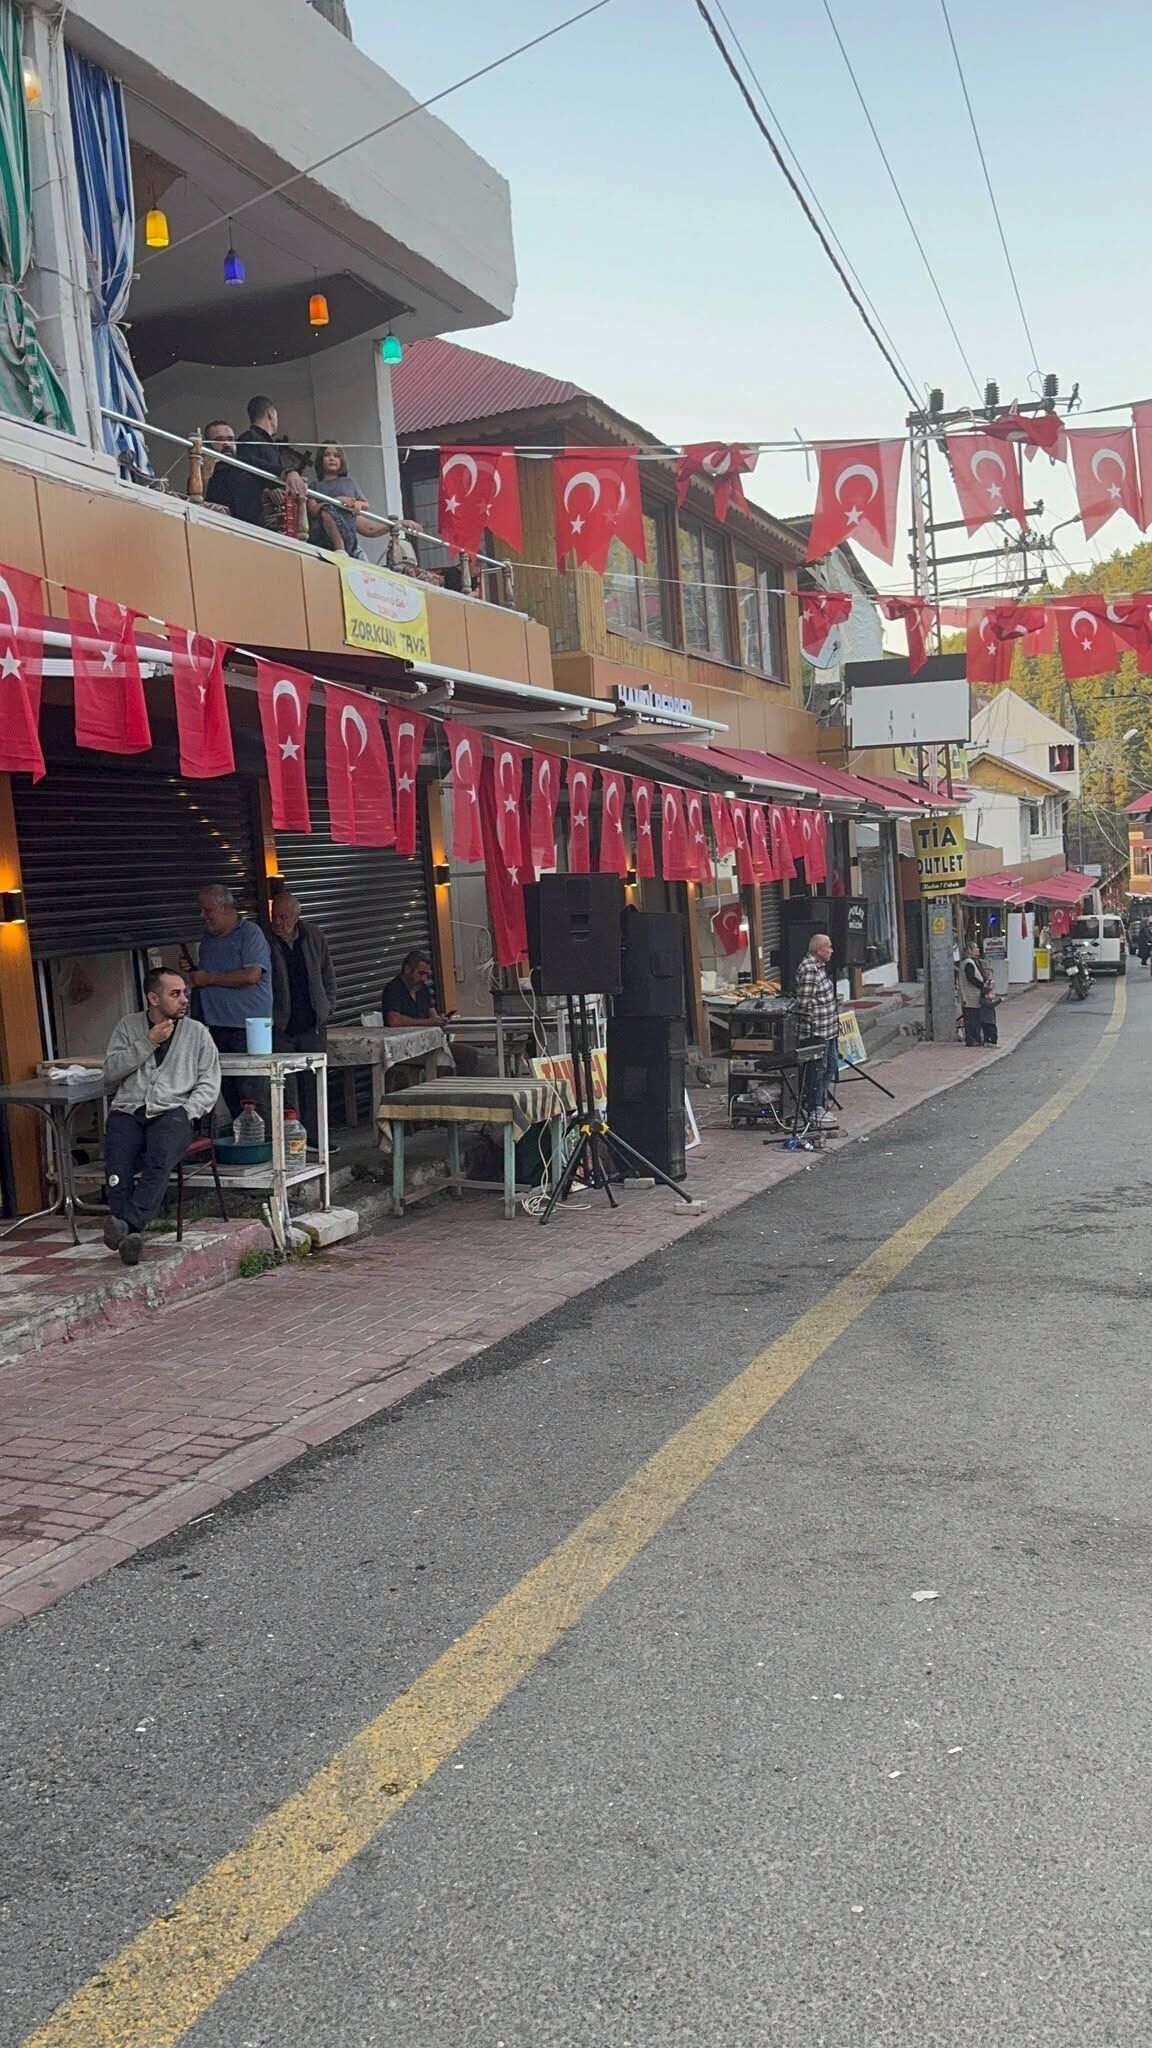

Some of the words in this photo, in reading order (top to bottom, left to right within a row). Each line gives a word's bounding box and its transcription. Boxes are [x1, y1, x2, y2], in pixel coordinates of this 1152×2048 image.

[350, 618, 397, 648] ZORKUN
[399, 633, 427, 657] TAVA
[918, 821, 957, 849] TİA
[917, 855, 963, 875] OUTLET
